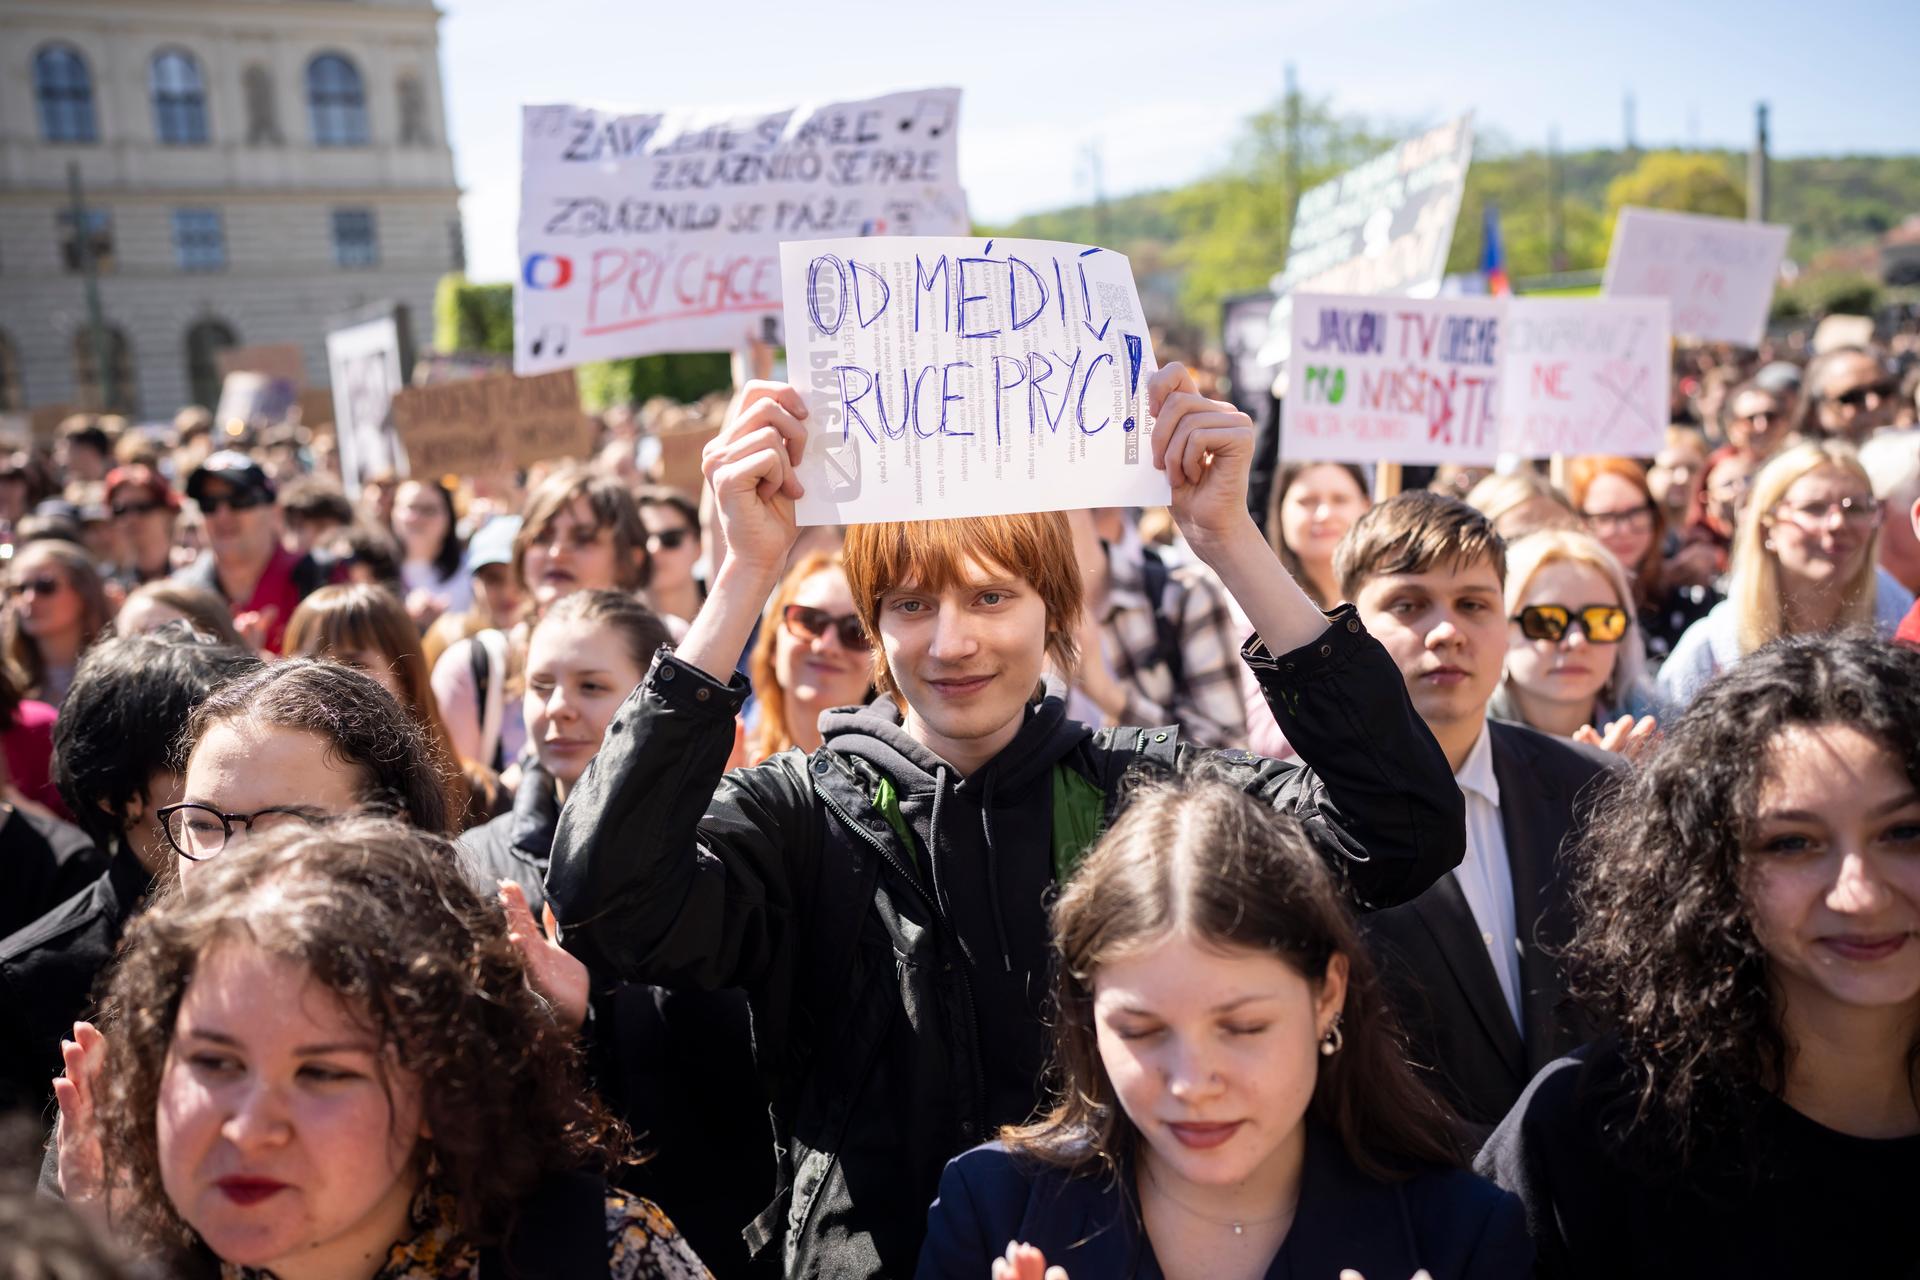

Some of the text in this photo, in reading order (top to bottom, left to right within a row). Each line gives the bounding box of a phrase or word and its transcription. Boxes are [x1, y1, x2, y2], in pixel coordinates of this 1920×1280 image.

[806, 253, 890, 335] OD
[1397, 311, 1440, 360] TV
[831, 361, 975, 445] RUCE
